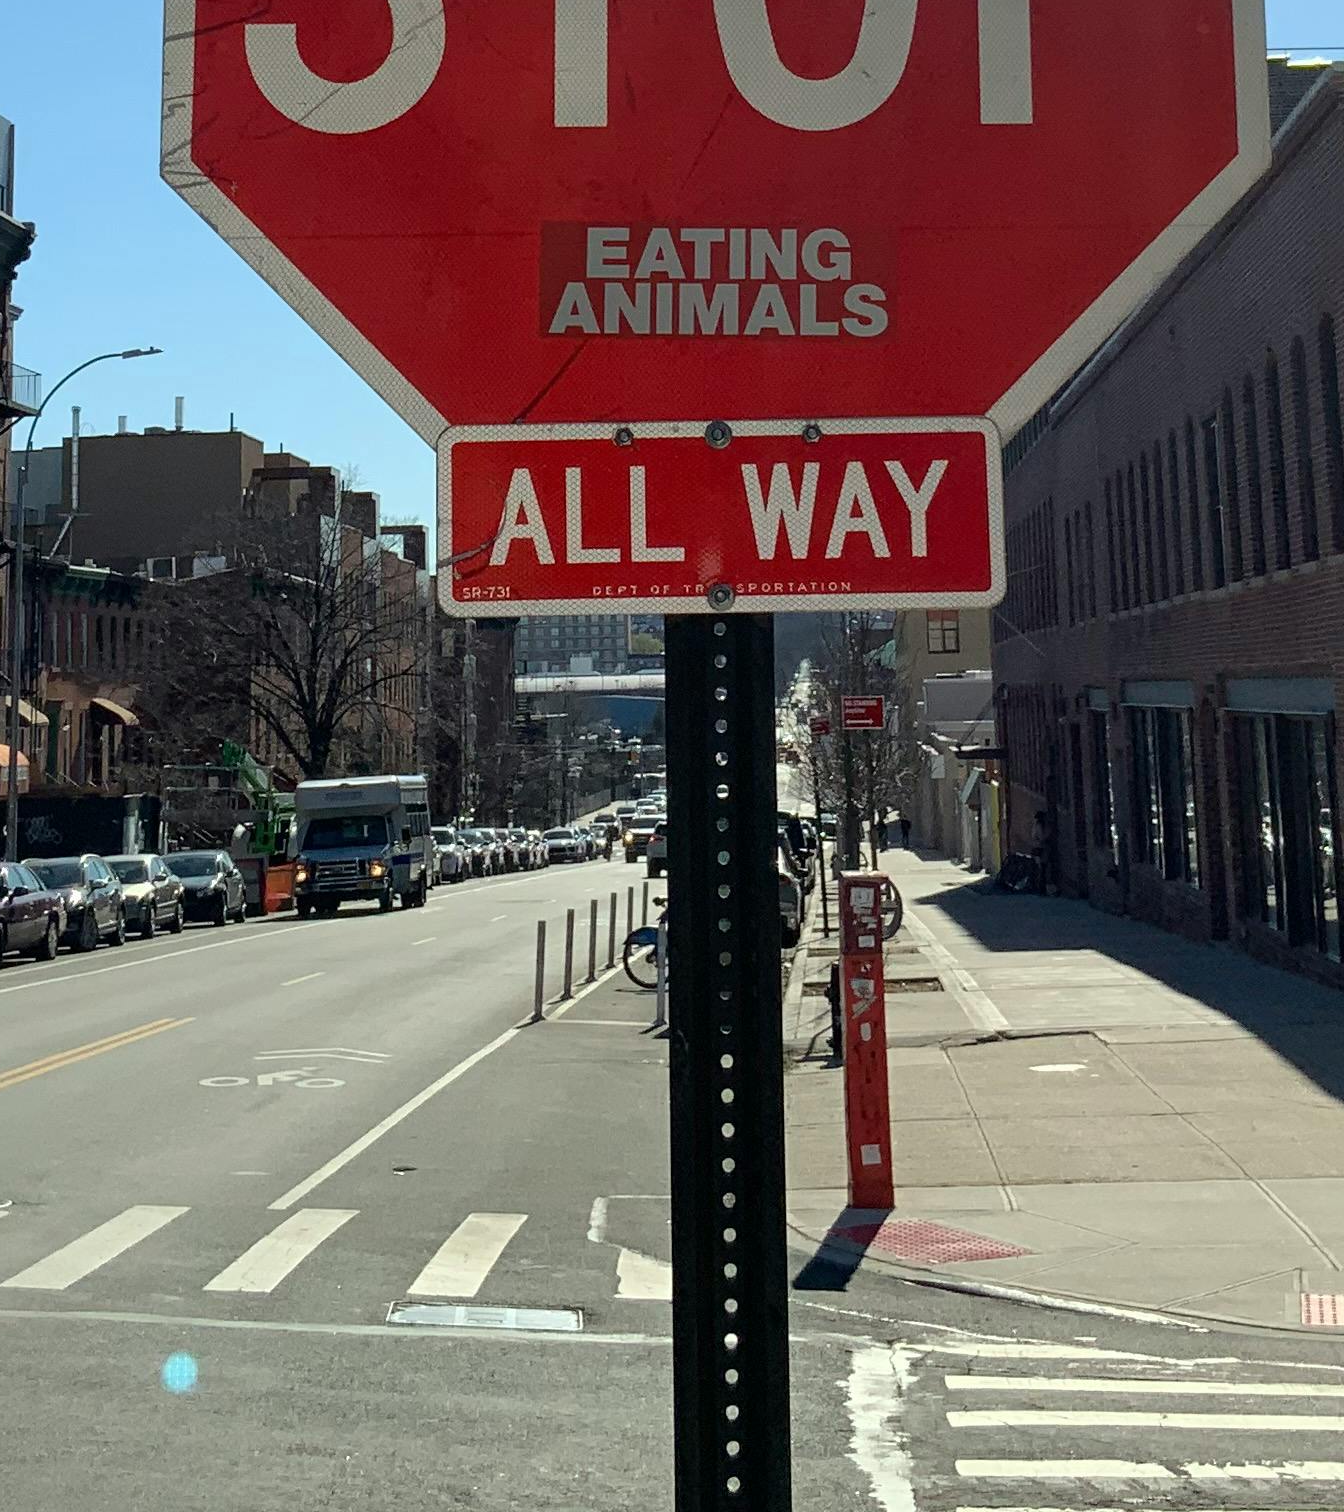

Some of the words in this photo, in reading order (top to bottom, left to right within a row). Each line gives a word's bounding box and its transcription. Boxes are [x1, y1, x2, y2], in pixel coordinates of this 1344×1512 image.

[586, 227, 852, 281] EATING
[548, 281, 889, 337] ANIMALS
[489, 465, 685, 566] ALL
[741, 459, 948, 560] WAY
[462, 586, 511, 599] SR-731
[592, 585, 638, 596] DEPT
[650, 585, 671, 595] OF
[683, 581, 852, 595] TRSPORTATION
